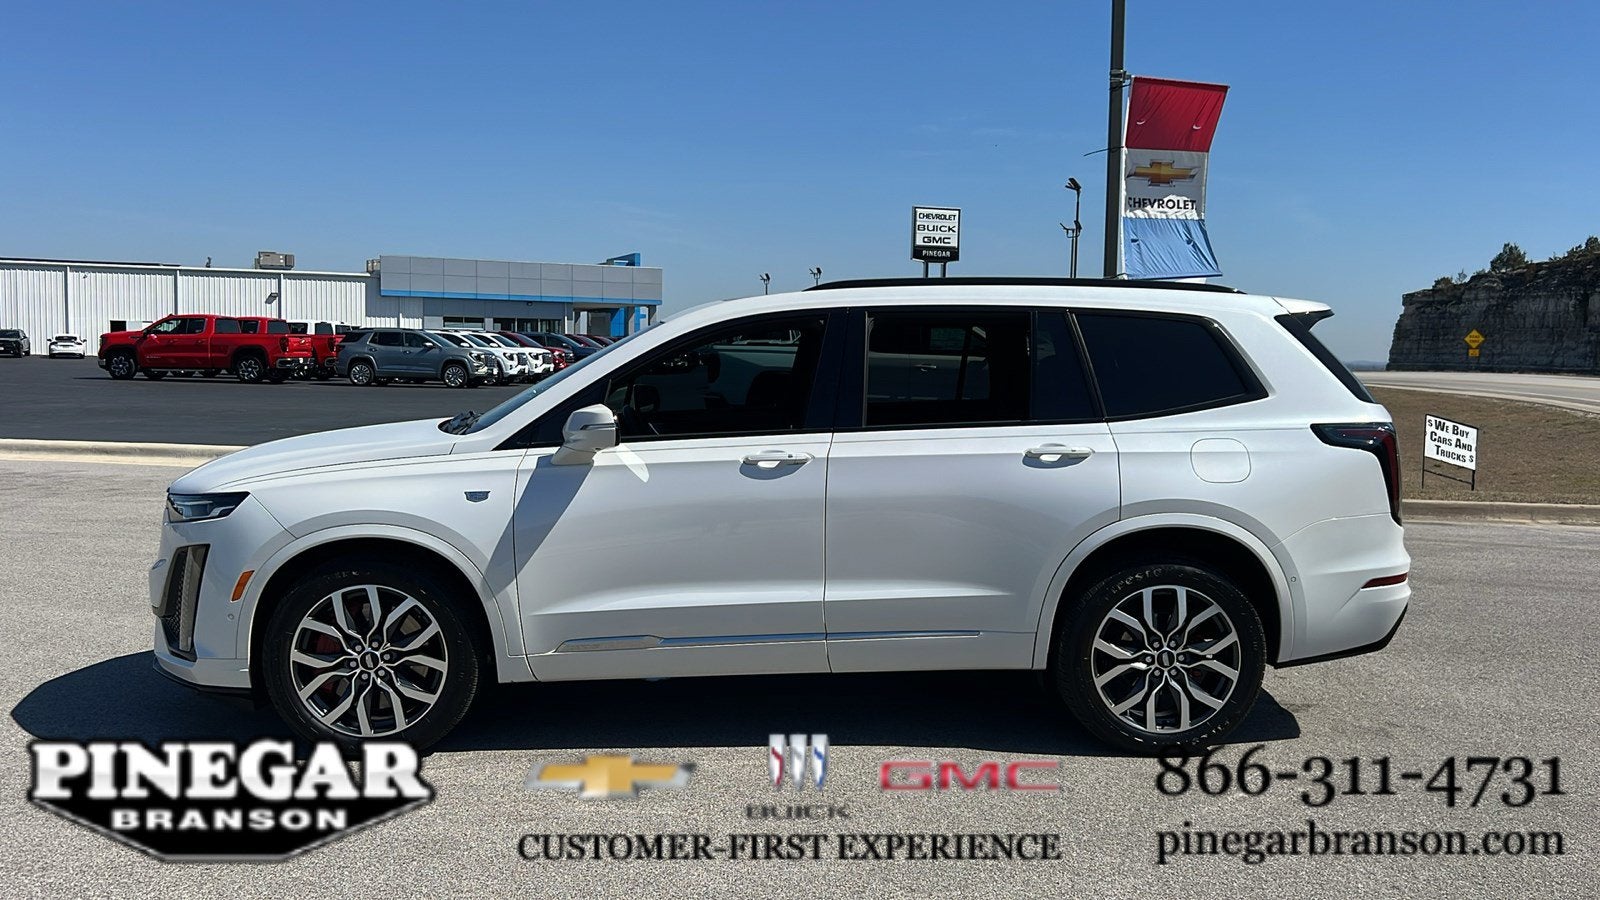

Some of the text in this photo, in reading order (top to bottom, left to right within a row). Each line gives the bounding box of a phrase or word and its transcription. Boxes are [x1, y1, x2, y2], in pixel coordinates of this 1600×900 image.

[918, 212, 957, 221] CHEVROLET
[917, 224, 957, 233] BUICK
[923, 236, 951, 244] GMC
